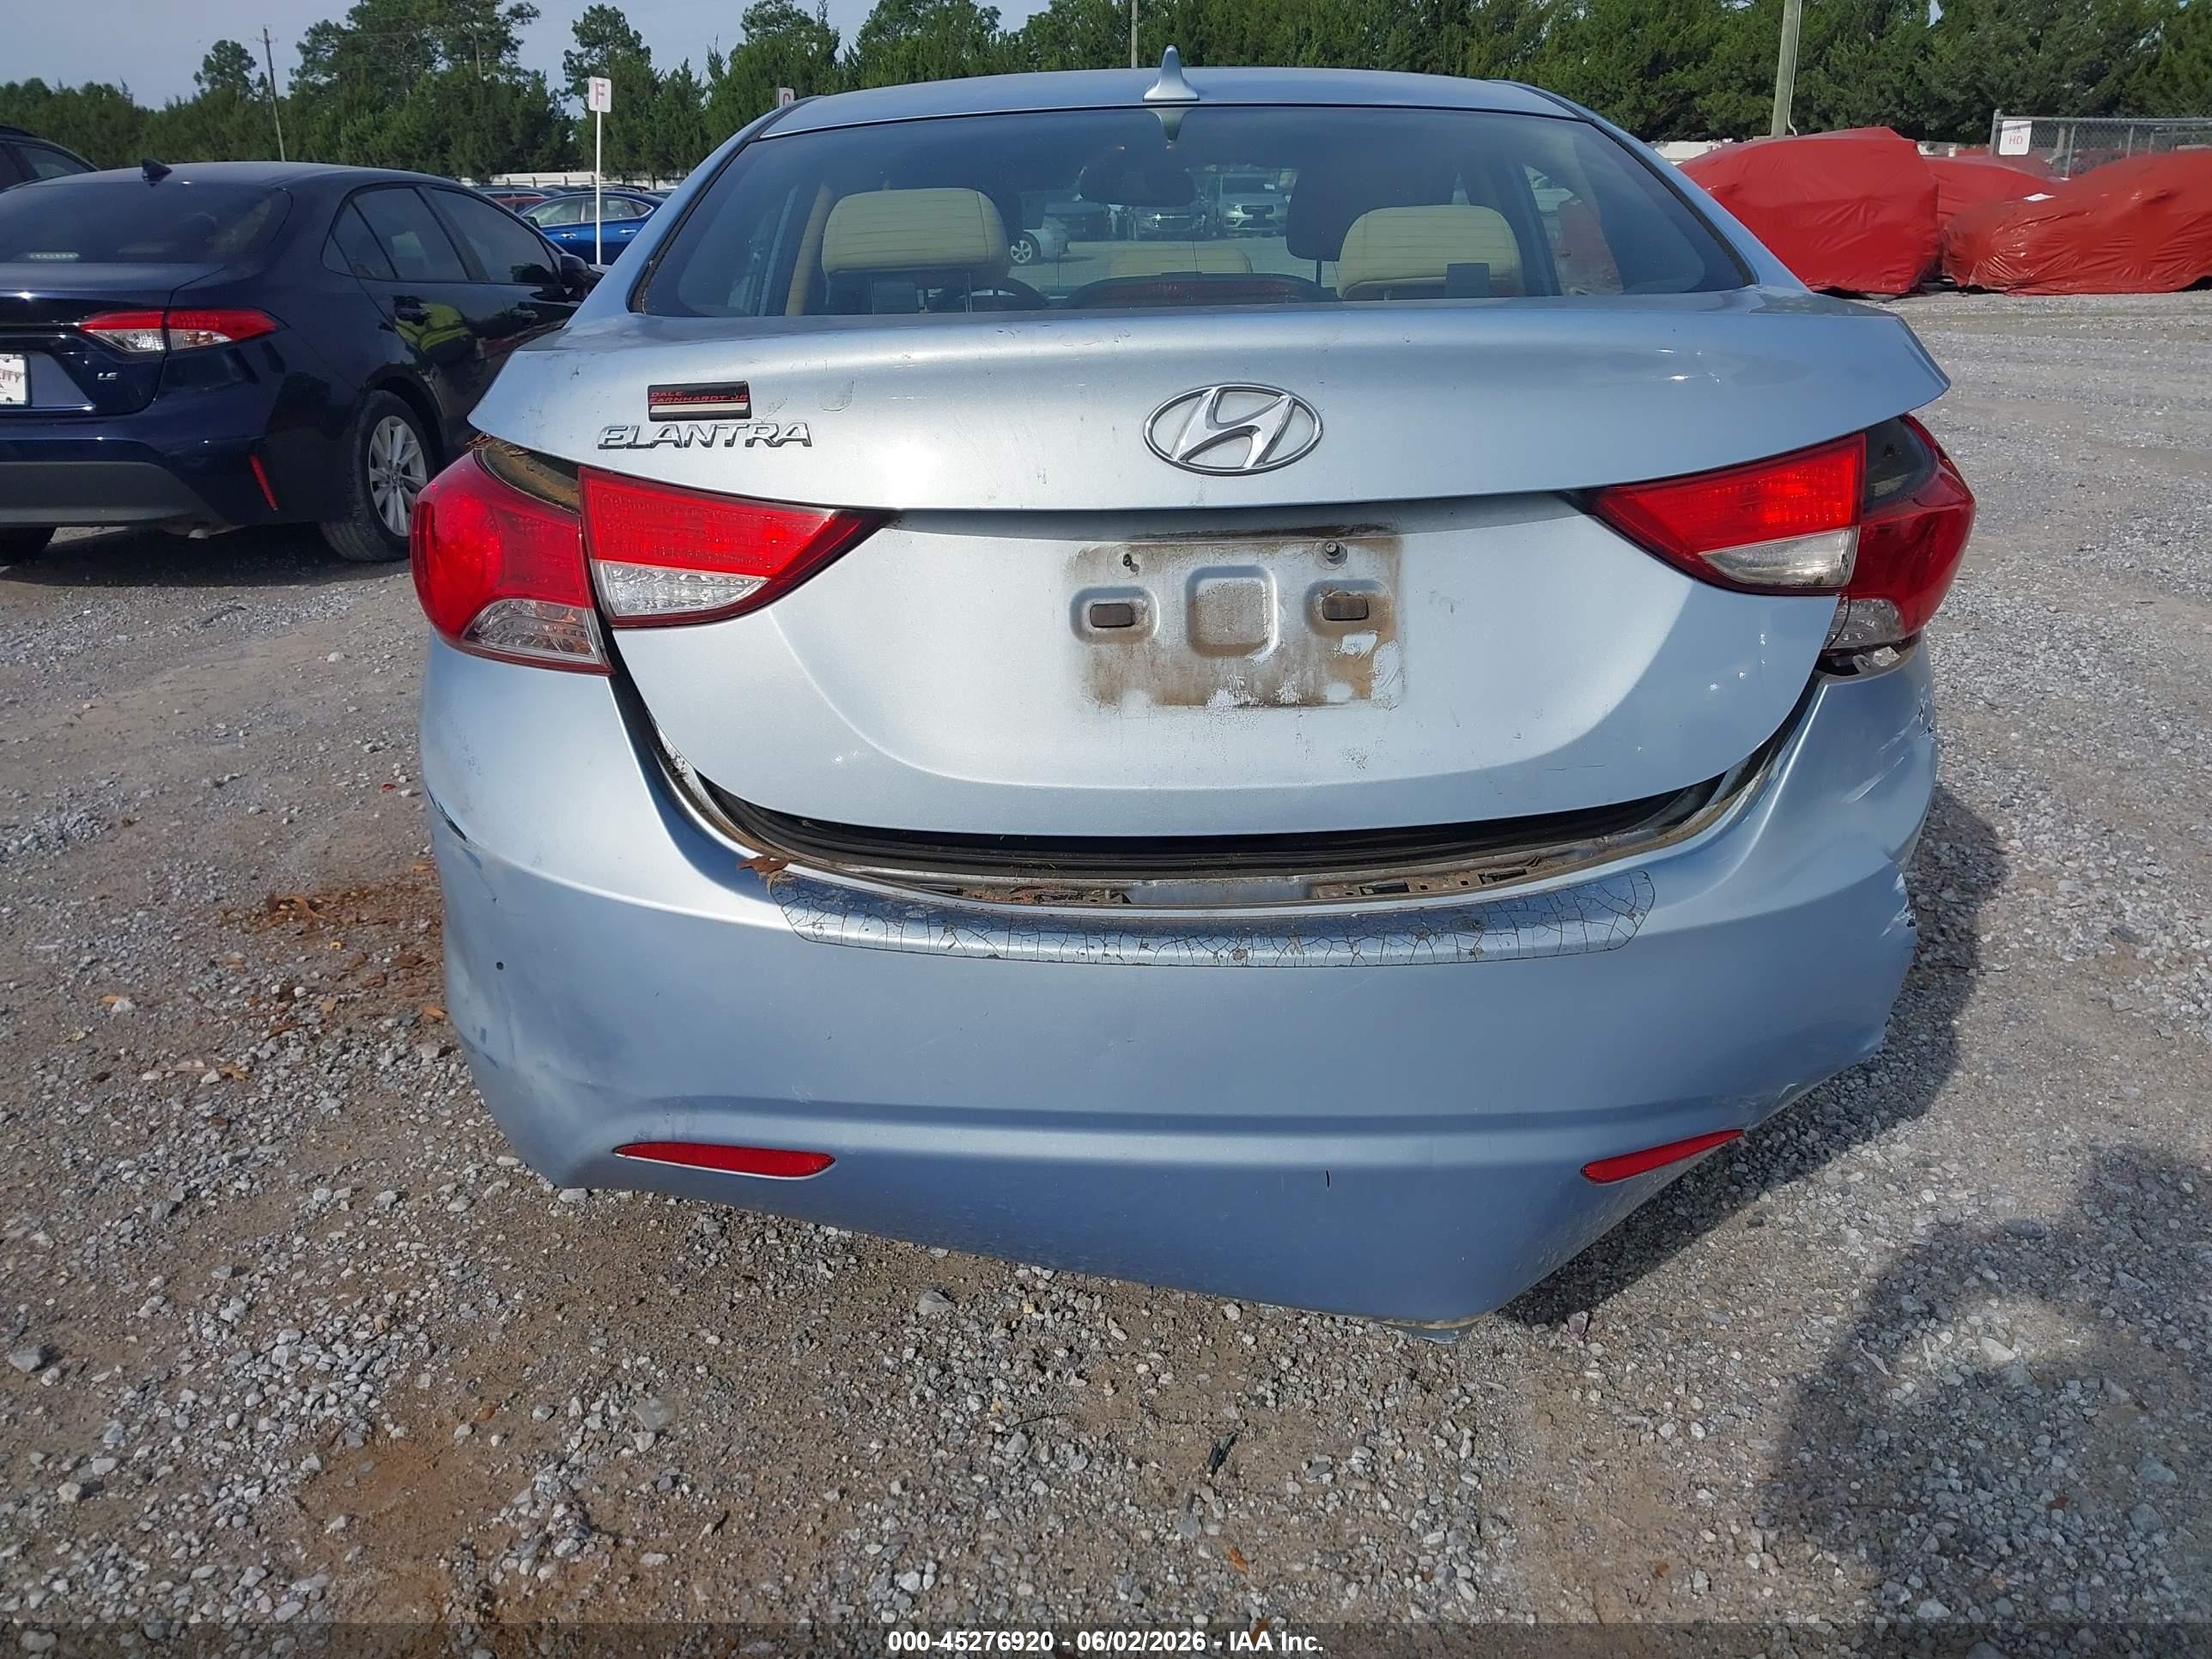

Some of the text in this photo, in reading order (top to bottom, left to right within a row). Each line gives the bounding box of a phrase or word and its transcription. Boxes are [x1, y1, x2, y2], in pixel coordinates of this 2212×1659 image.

[595, 82, 605, 106] F
[0, 368, 22, 384] ITY
[97, 372, 118, 380] LE
[598, 422, 813, 450] ELANTRA
